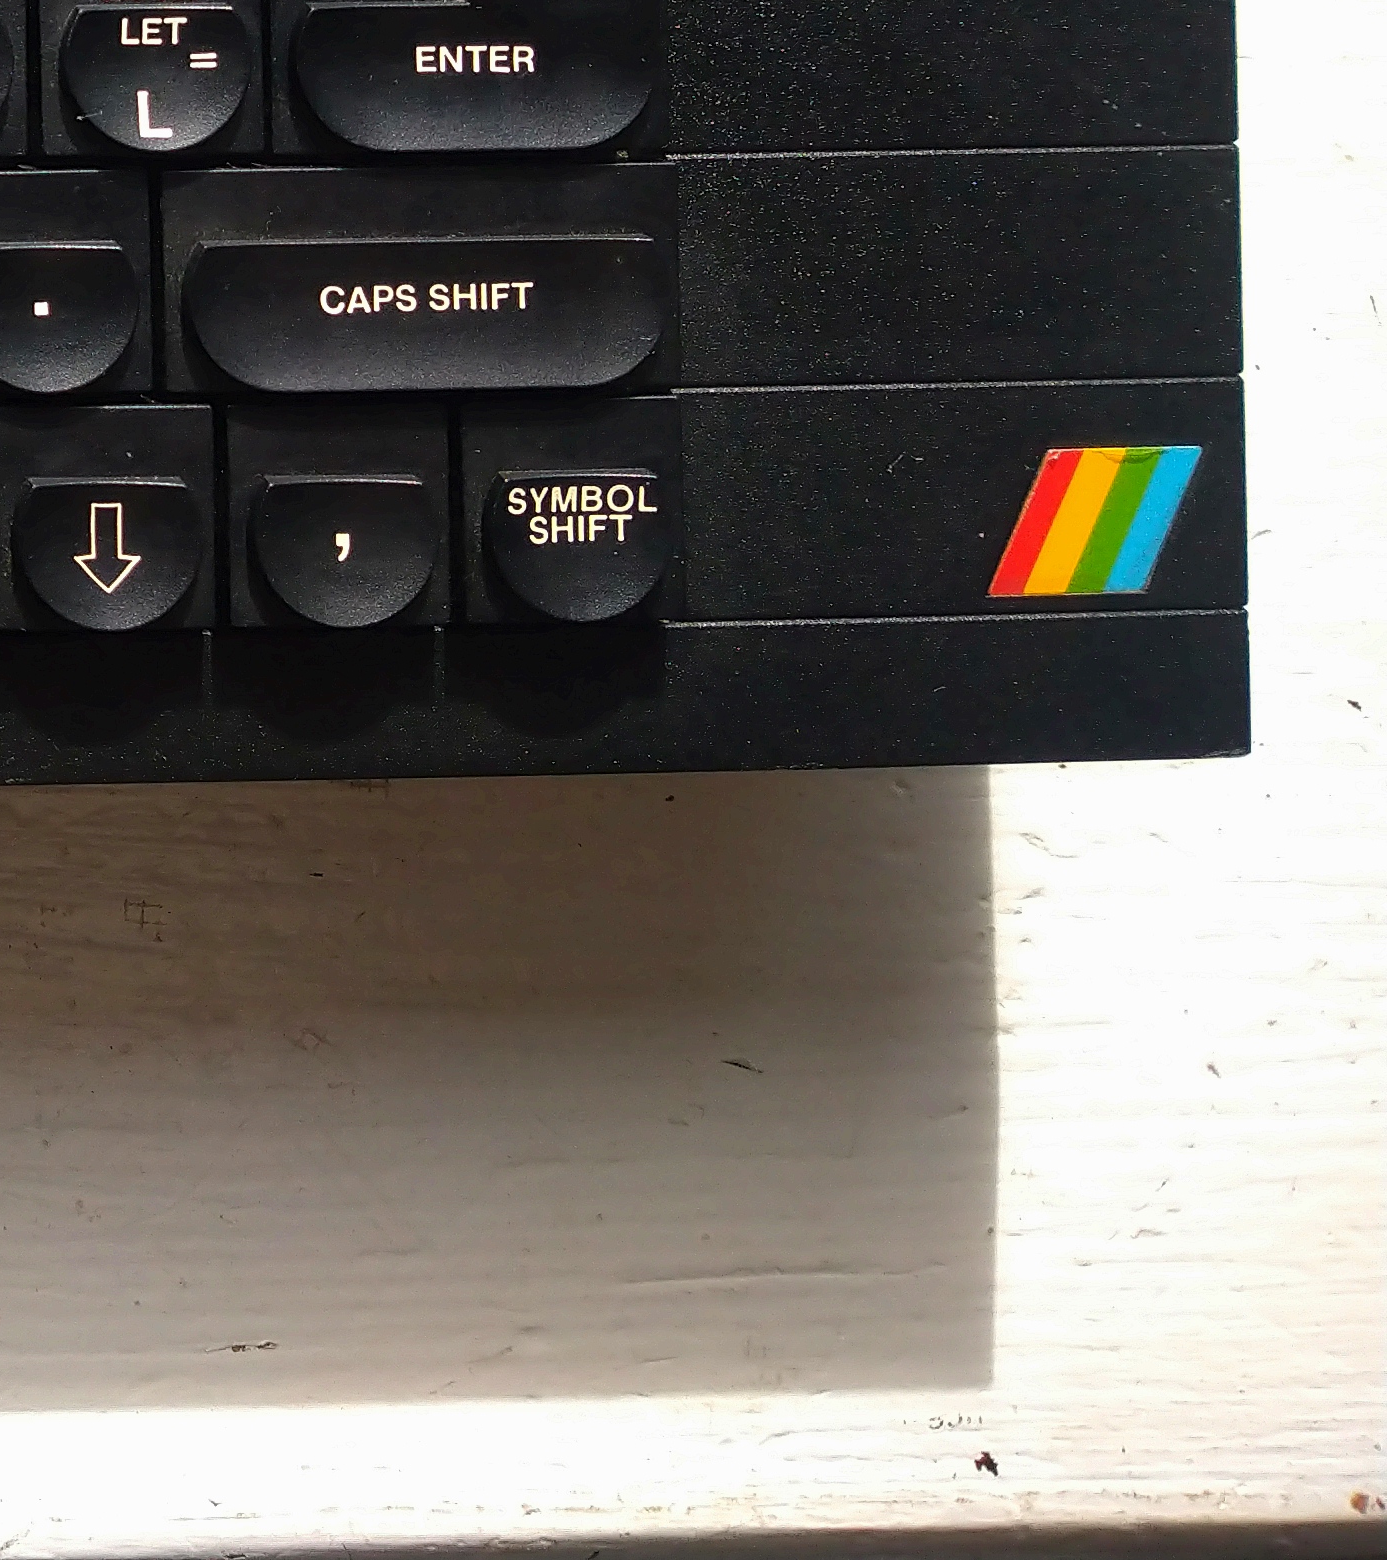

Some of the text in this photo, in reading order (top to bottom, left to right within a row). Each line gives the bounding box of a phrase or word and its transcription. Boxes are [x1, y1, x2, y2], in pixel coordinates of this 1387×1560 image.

[120, 16, 188, 45] LET
[415, 45, 535, 74] ENTER
[319, 281, 534, 315] CAPS SHIFT
[507, 484, 658, 515] SYMBOL
[529, 513, 633, 545] SHIFT
